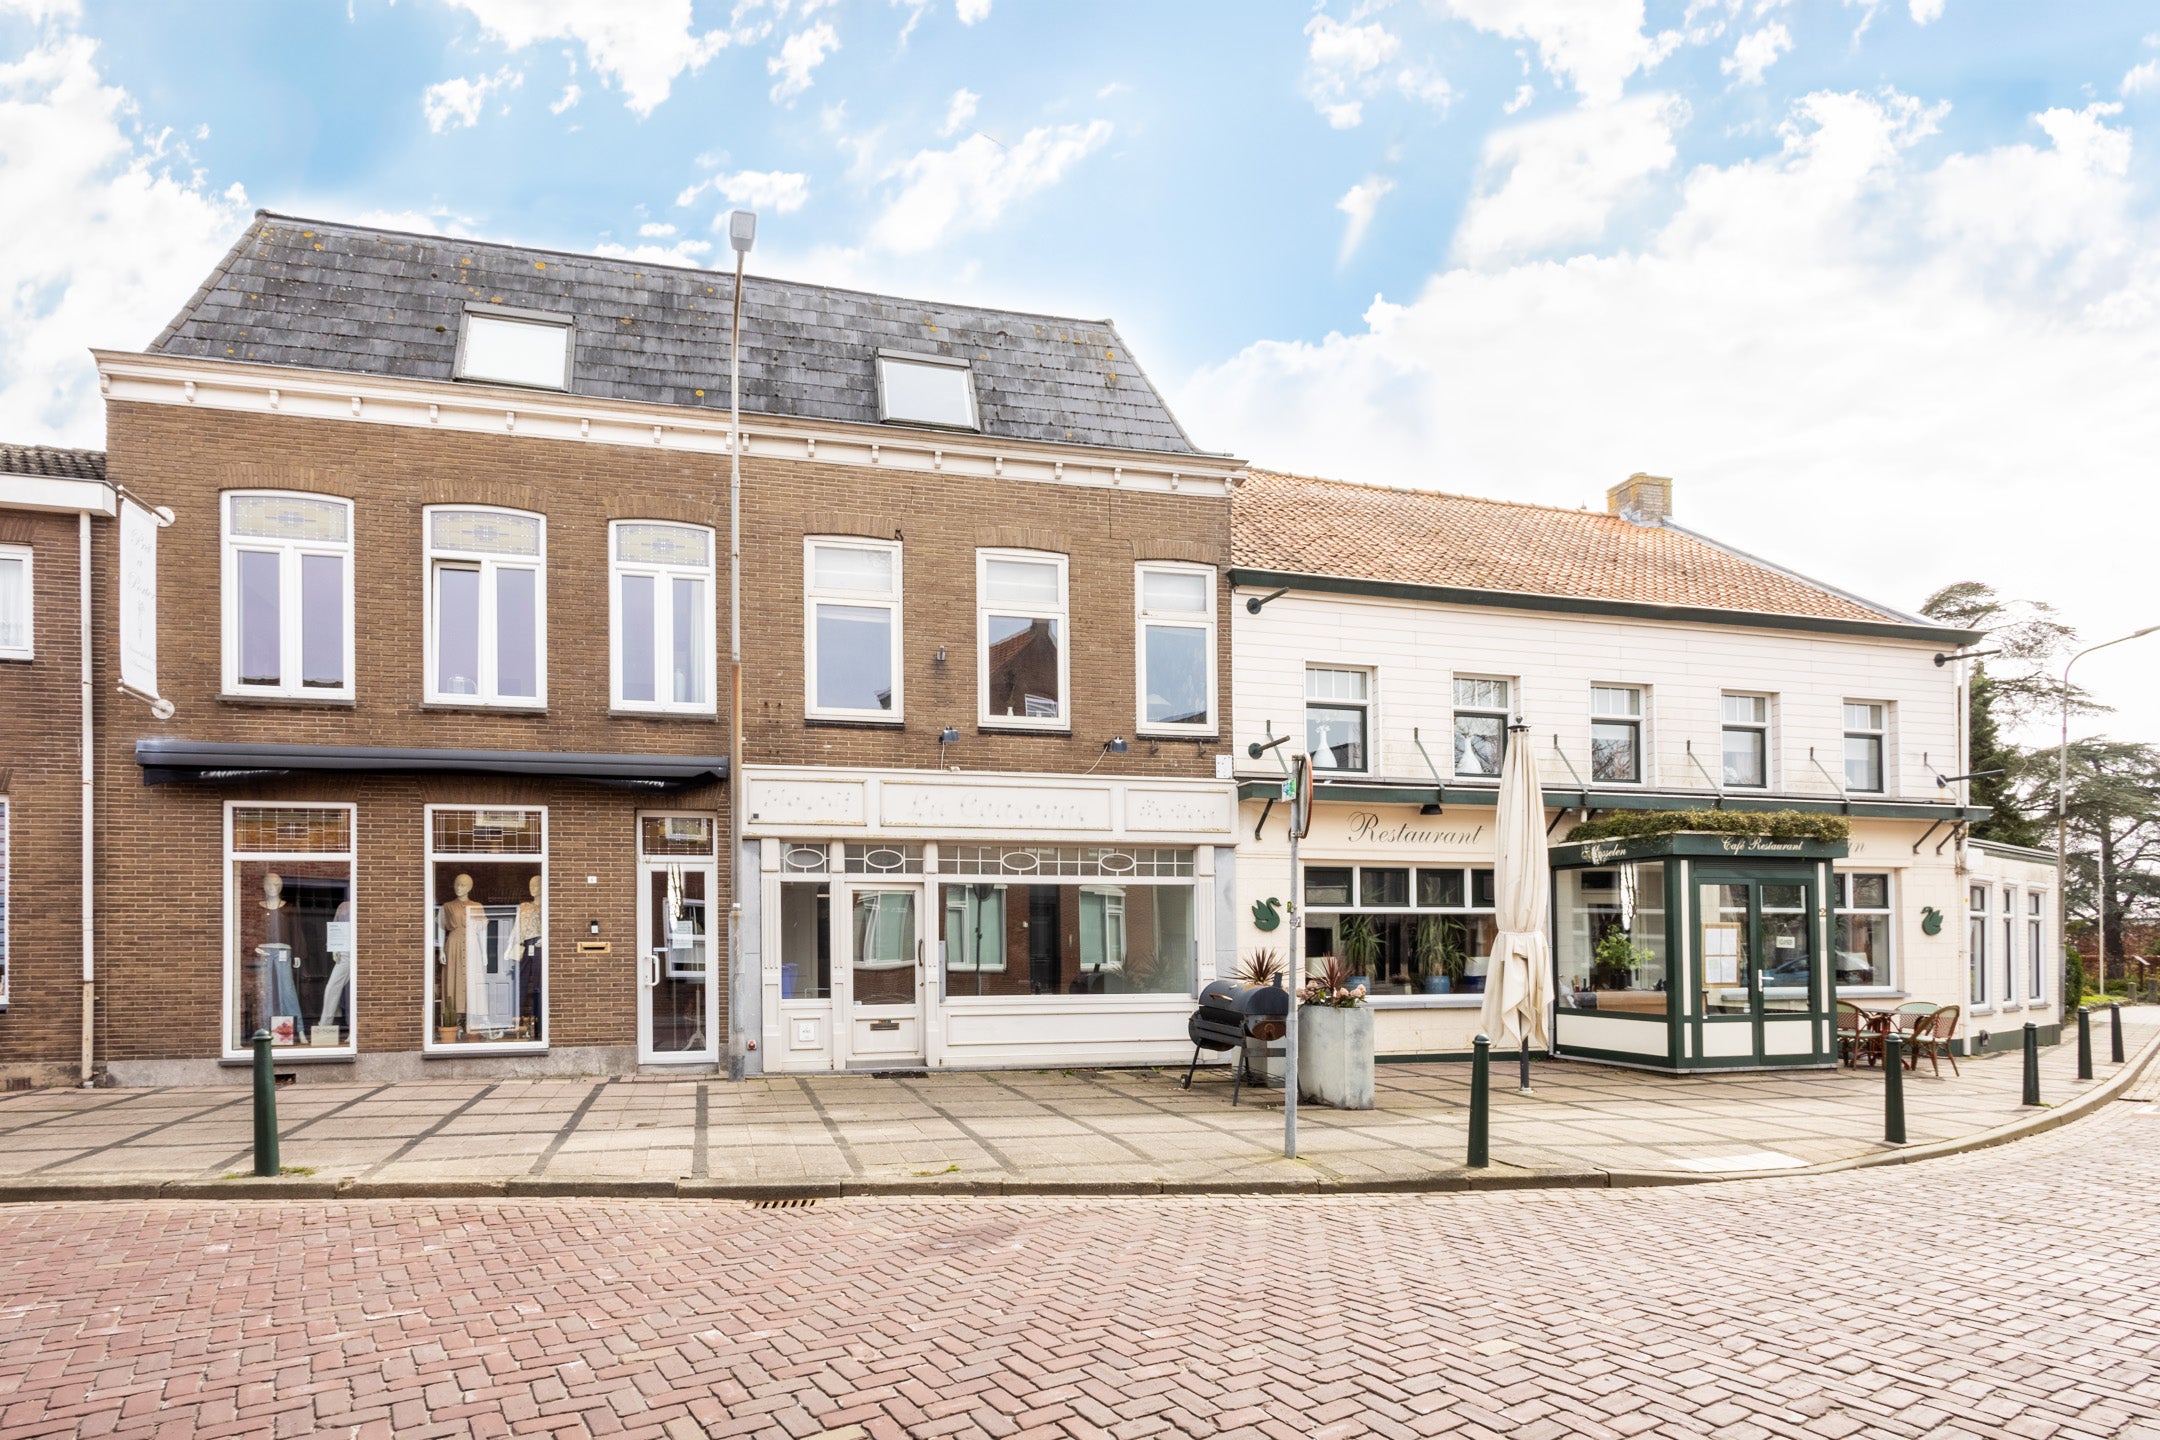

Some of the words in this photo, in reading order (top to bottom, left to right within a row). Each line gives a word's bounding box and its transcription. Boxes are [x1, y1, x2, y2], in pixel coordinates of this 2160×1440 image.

[1346, 811, 1485, 845] Restaurant
[1721, 836, 1746, 855] Café
[1747, 836, 1804, 850] Restaurant
